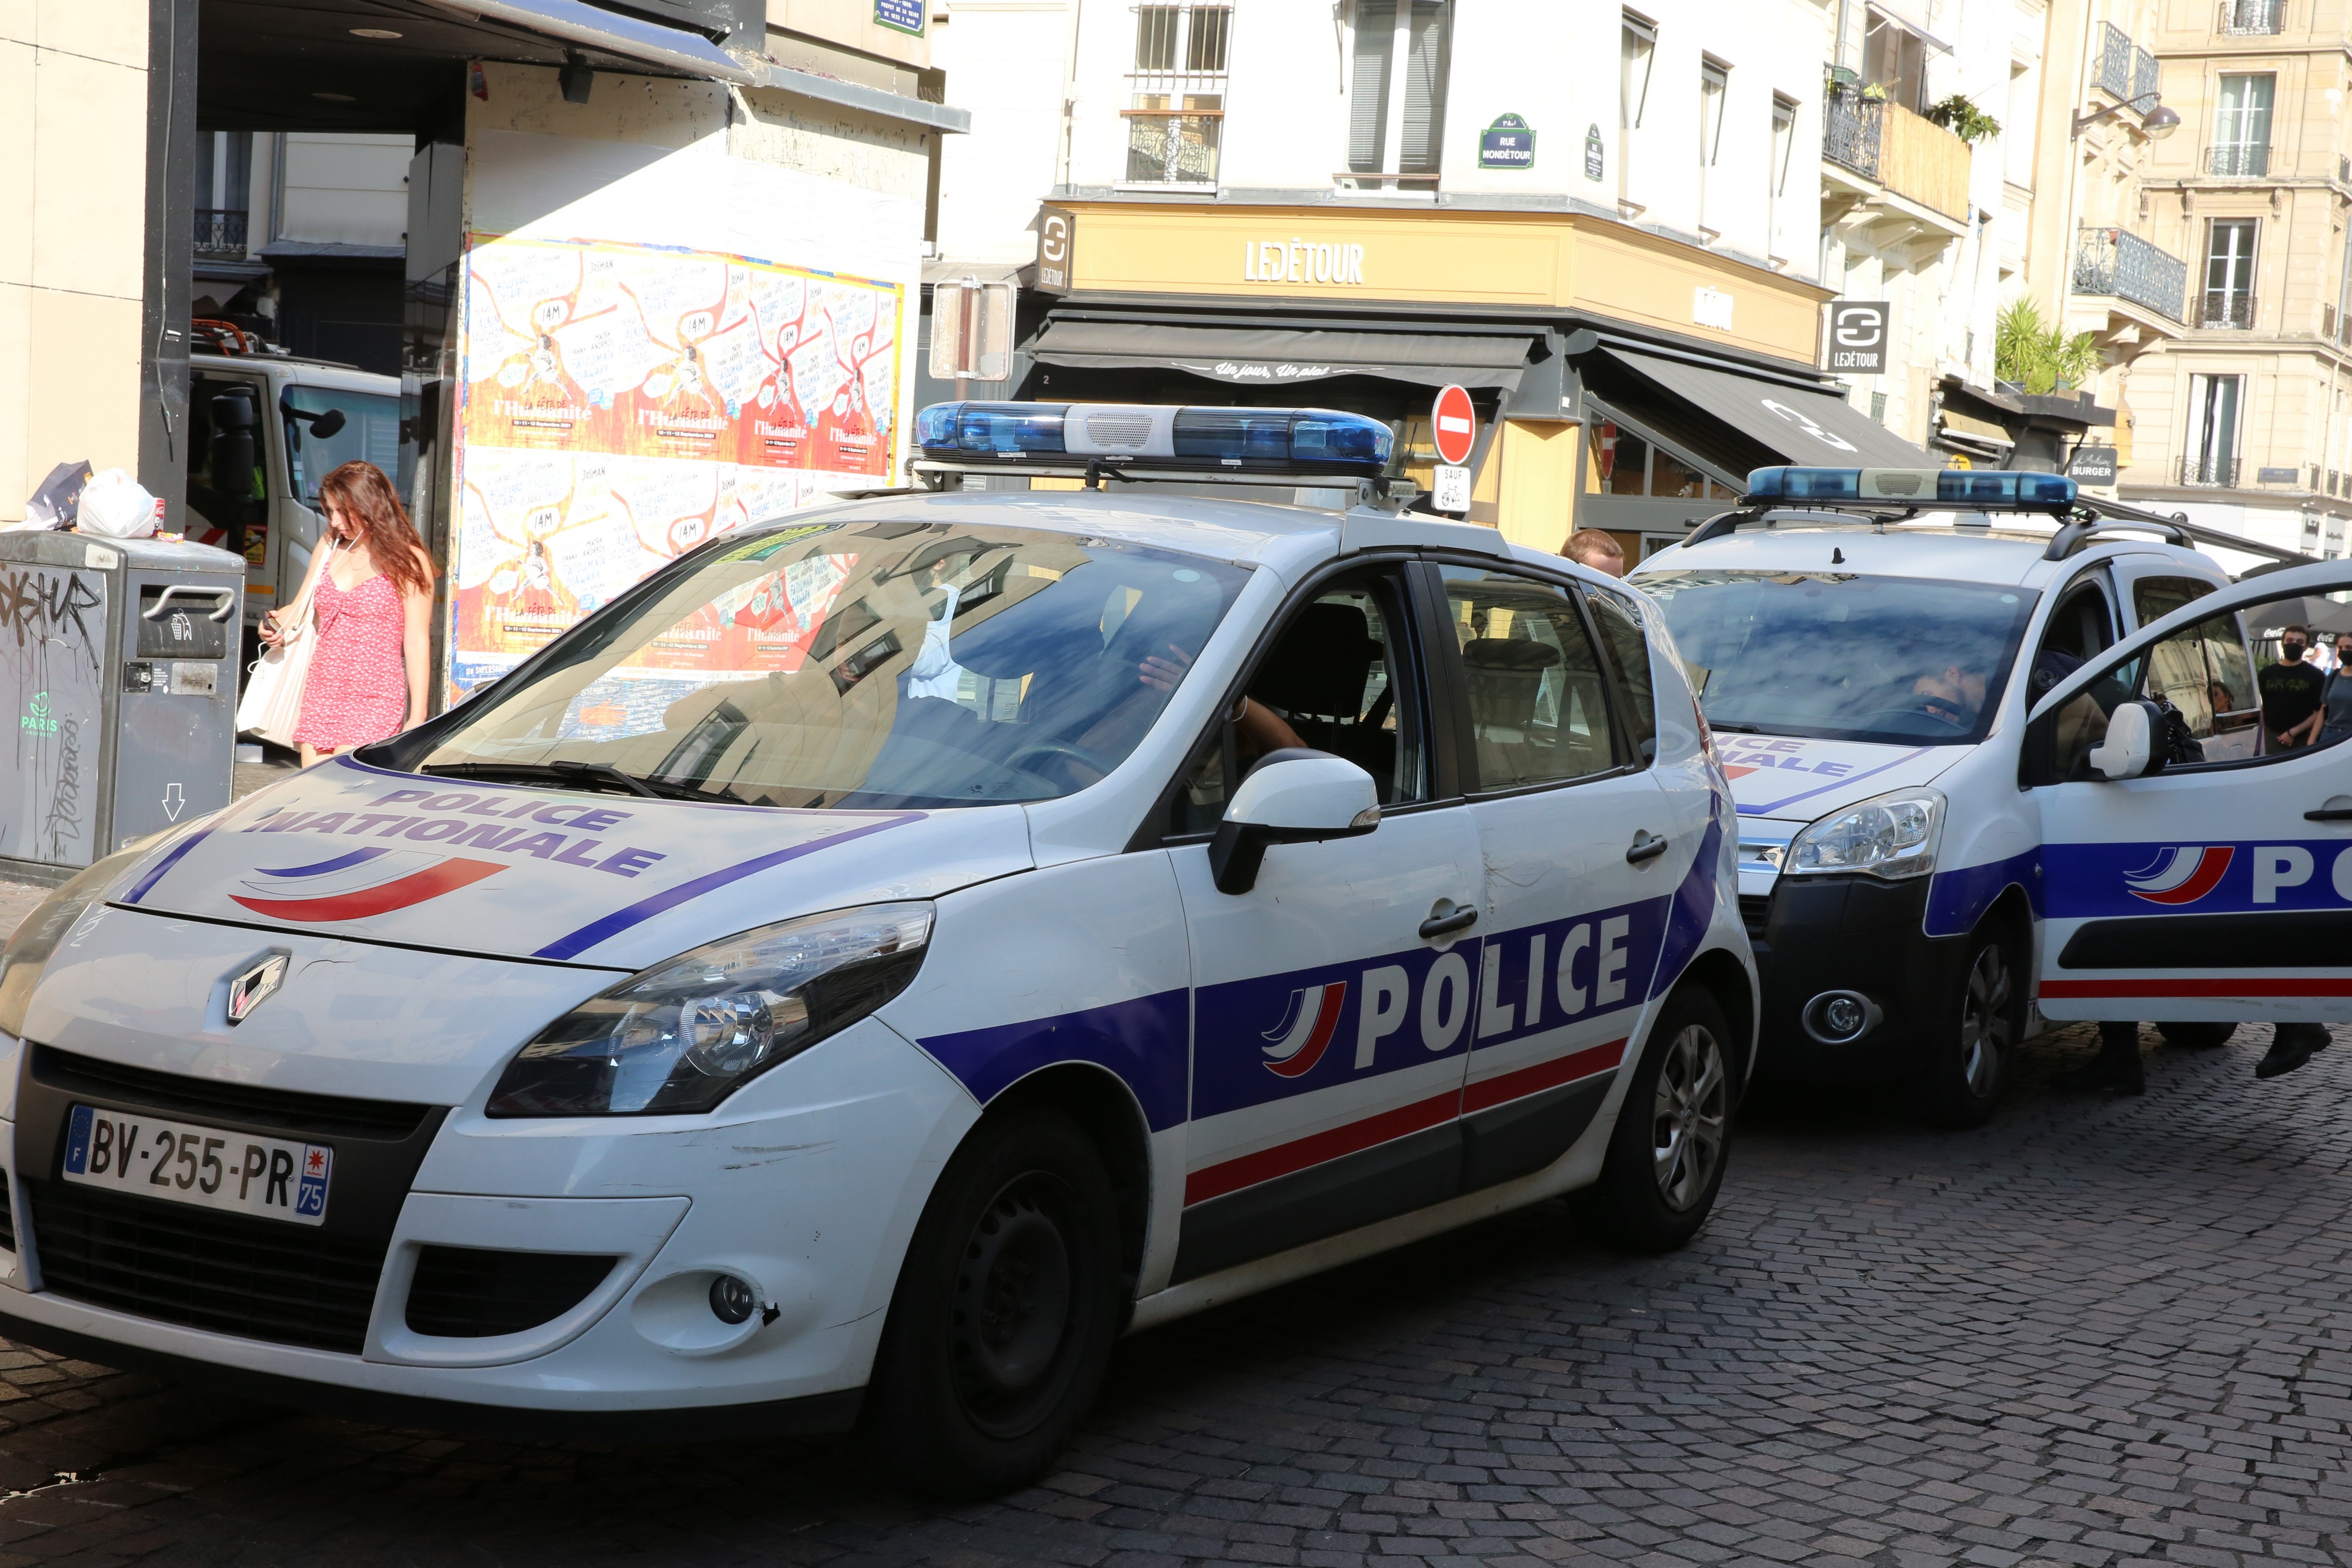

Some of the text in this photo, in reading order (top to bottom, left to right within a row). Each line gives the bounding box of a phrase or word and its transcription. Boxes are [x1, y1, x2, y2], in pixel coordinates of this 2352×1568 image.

[1500, 137, 1515, 146] RUE
[1483, 149, 1531, 159] MONDÉTOUR
[590, 260, 613, 273] JOSMAN
[1245, 237, 1364, 284] LEDÉTOUR
[809, 286, 822, 299] JOSMAN
[542, 305, 560, 322] IAM
[880, 299, 891, 312] JOSMAN
[688, 317, 706, 333] IAM
[784, 329, 794, 345] IAM
[857, 341, 866, 355] IAM
[1296, 366, 1329, 377] plat
[1043, 376, 1049, 384] 2
[493, 399, 593, 420] l'Humanité
[524, 402, 533, 411] LA
[557, 399, 566, 409] DE
[638, 409, 729, 430] l'Humanité
[669, 412, 677, 421] LA
[701, 410, 710, 419] DE
[754, 420, 807, 439] l'Humanité
[830, 427, 877, 446] l'Humanité
[582, 466, 606, 480] JOSMAN
[1445, 469, 1462, 480] SAUF
[2072, 466, 2111, 476] BURGER
[721, 477, 736, 492] JOSMAN
[534, 512, 553, 529] IAM
[679, 523, 696, 540] IAM
[583, 545, 606, 556] ANDRADE
[485, 605, 583, 625] l'Humanité
[516, 607, 524, 617] LA
[548, 606, 557, 614] DE
[658, 626, 722, 641] umanité
[747, 627, 800, 643] l'Humanité
[22, 716, 57, 732] PARIS
[1715, 735, 1807, 753] ICE
[363, 789, 636, 832] POLICE
[239, 811, 668, 878] NATIONALE
[1354, 914, 1630, 1070] POLICE
[73, 1147, 81, 1162] F
[90, 1118, 294, 1207] BV-255-PR
[299, 1183, 322, 1211] 75
